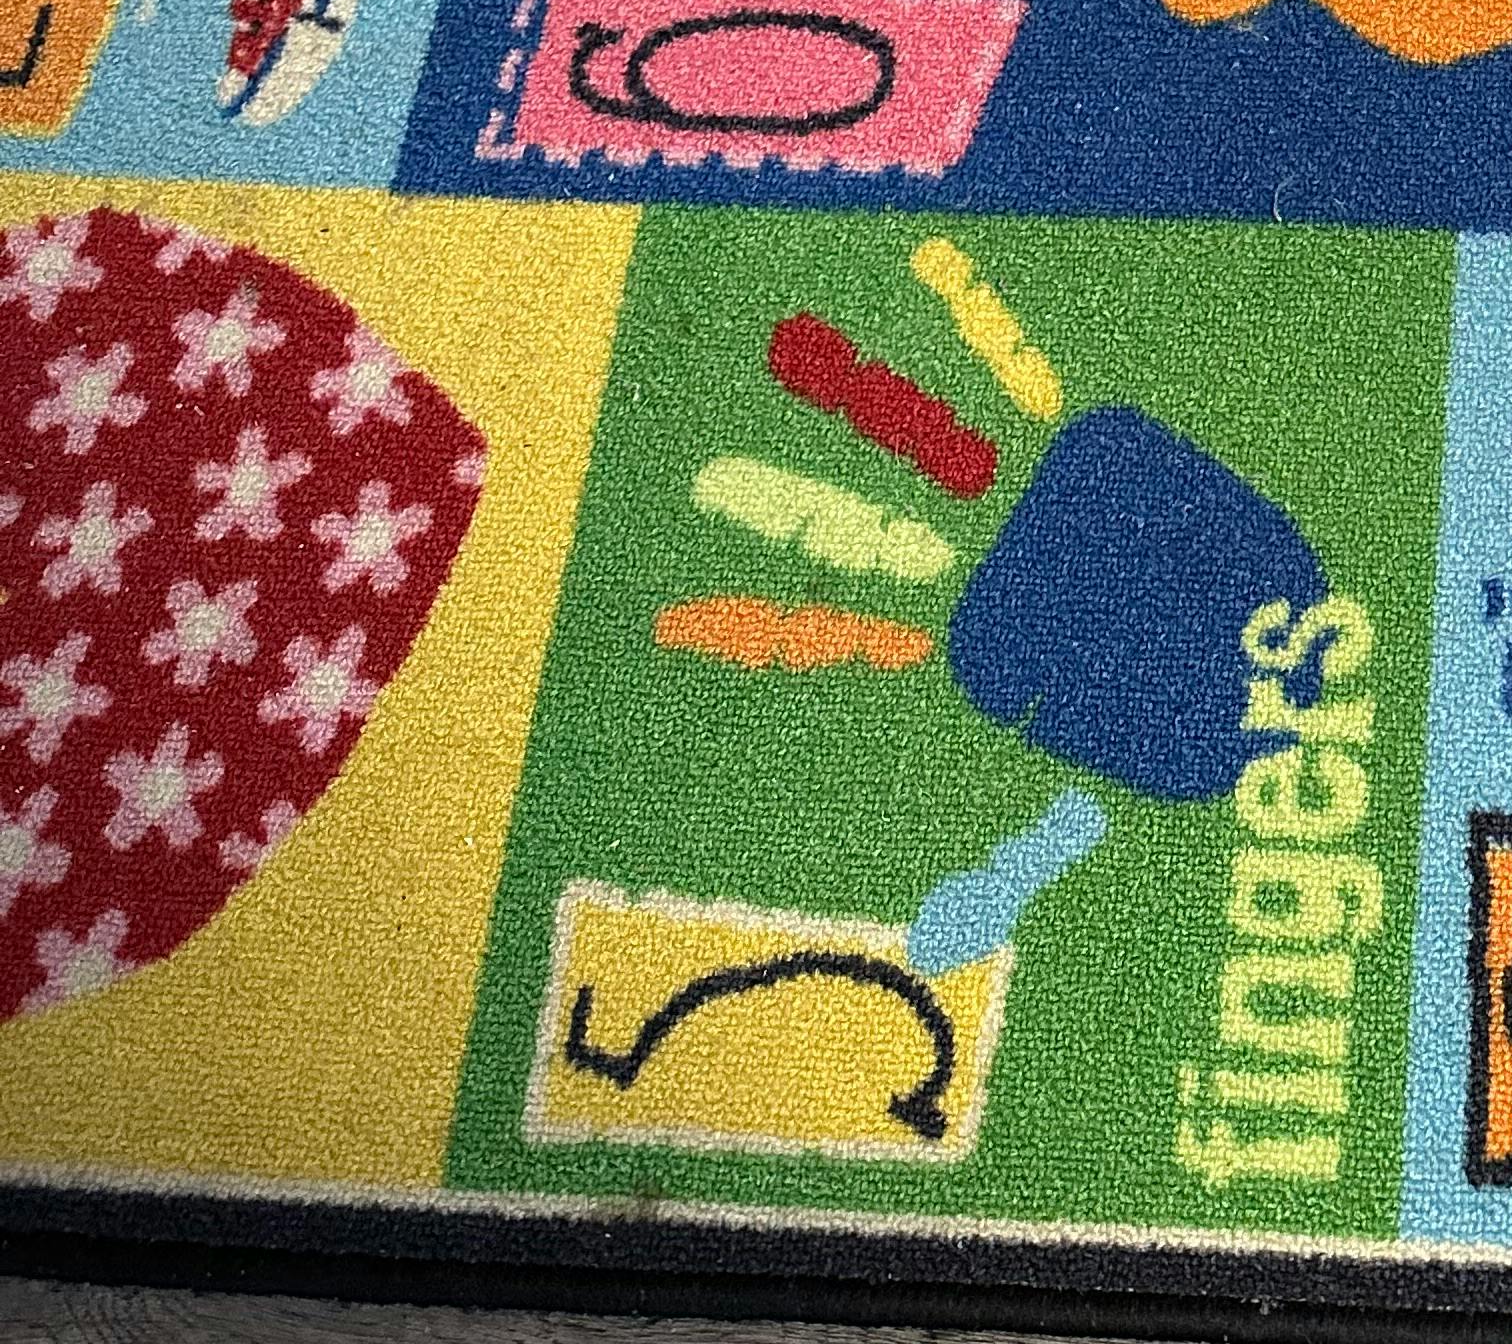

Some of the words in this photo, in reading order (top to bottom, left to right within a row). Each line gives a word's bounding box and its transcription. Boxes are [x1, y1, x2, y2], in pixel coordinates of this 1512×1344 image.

[566, 8, 897, 137] 6
[1175, 591, 1386, 1192] fingers
[562, 950, 960, 1143] 5
